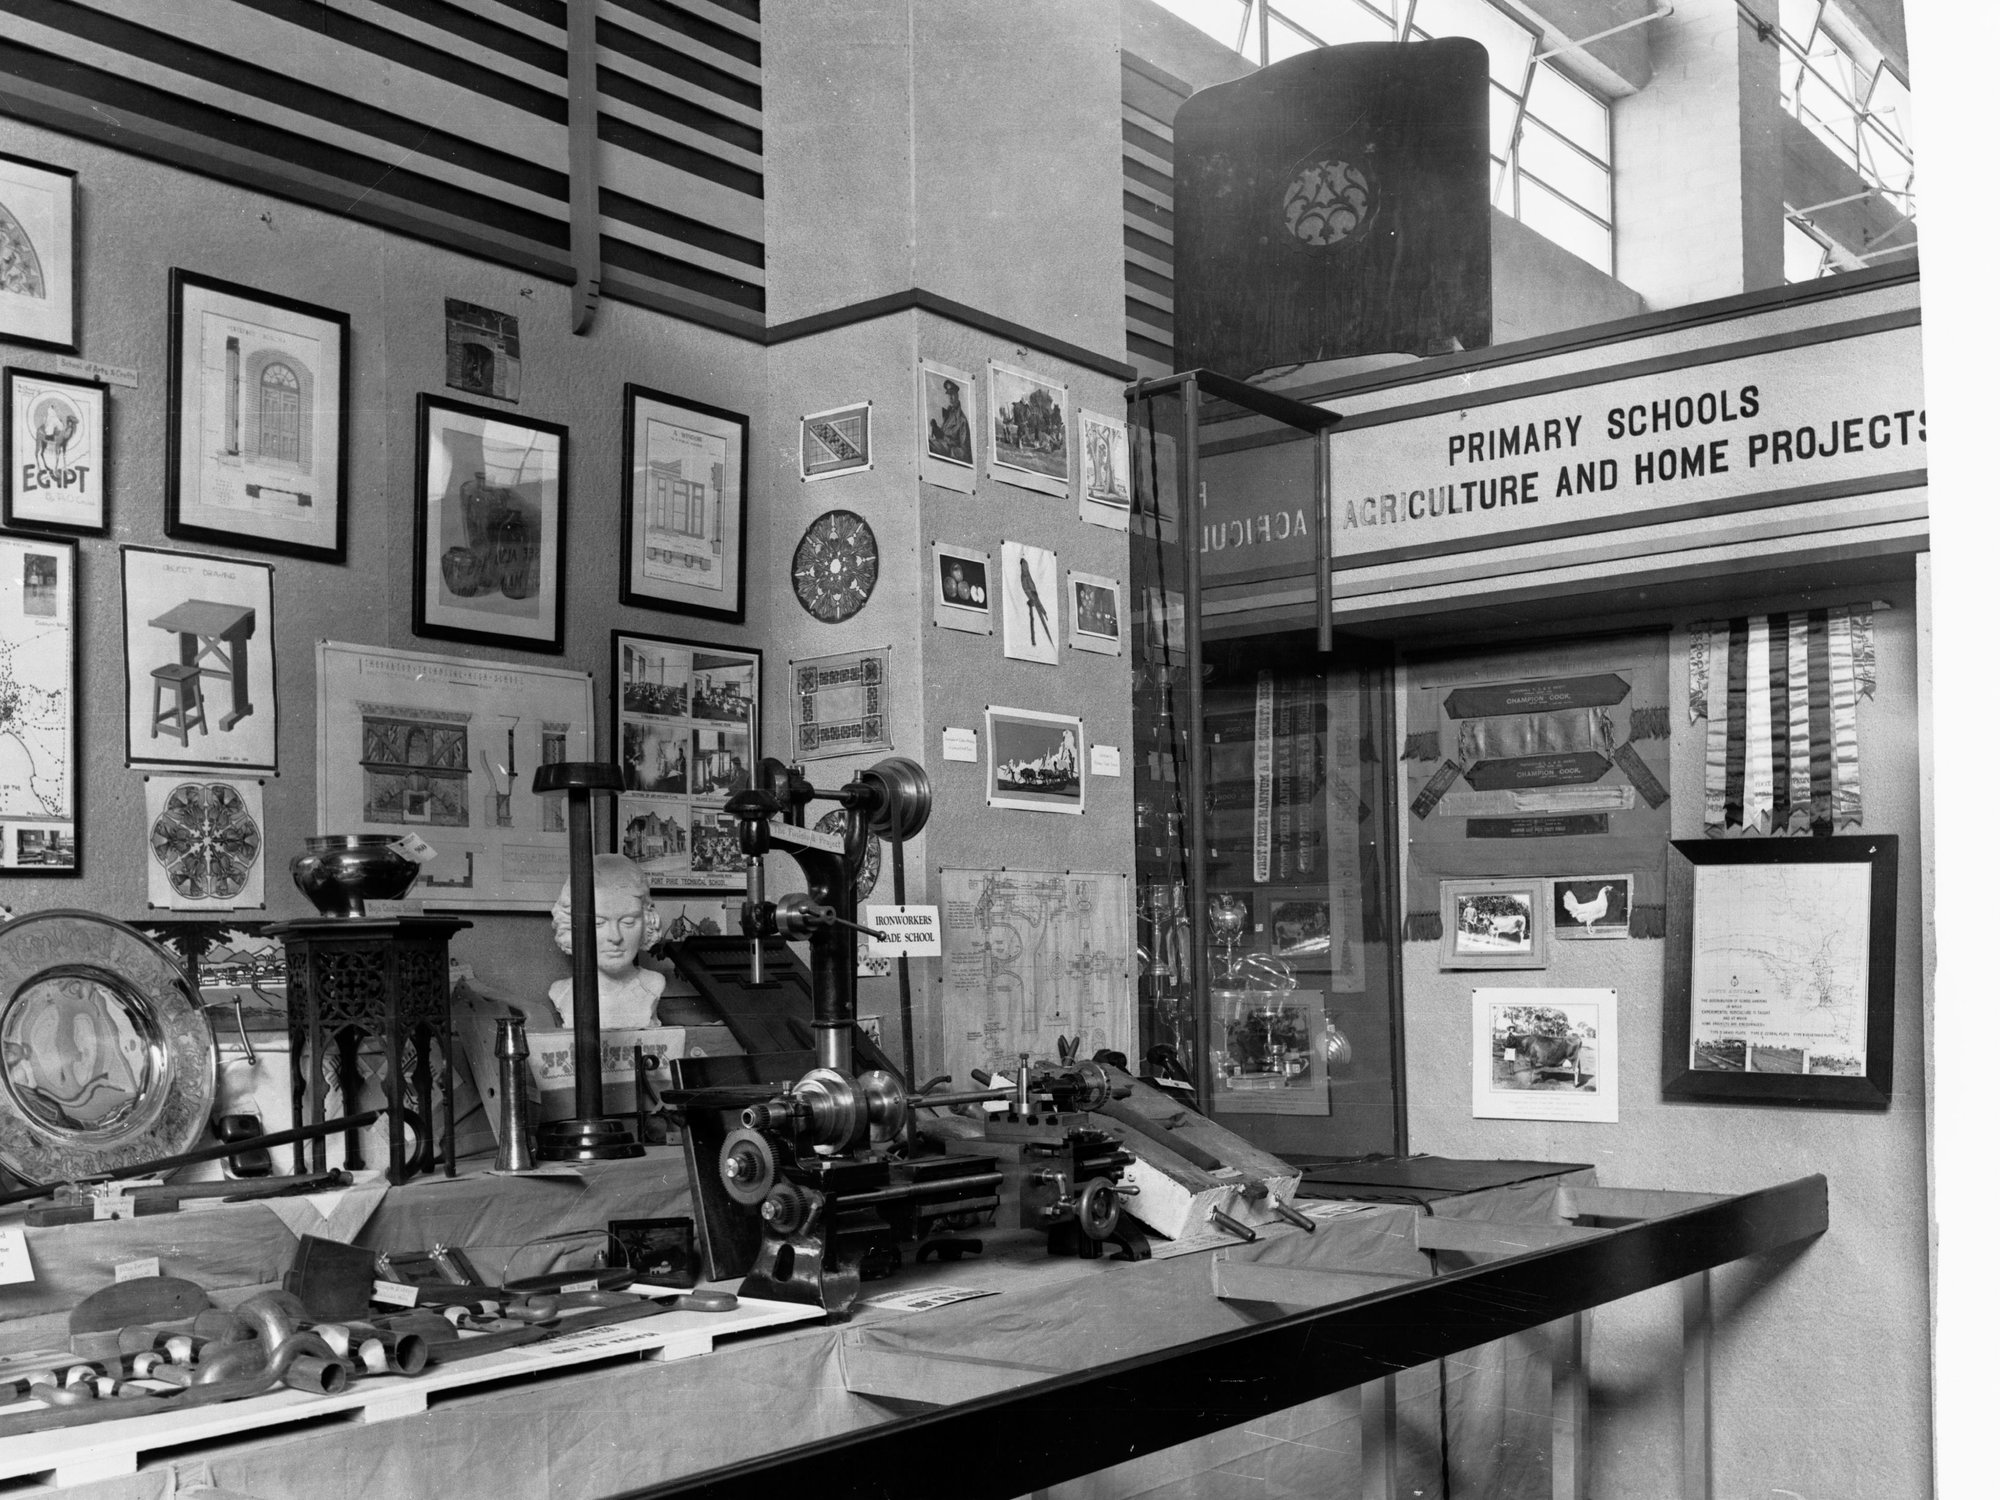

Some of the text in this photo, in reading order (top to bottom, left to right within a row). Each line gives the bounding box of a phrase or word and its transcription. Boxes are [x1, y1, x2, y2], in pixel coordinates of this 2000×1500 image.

[93, 365, 108, 376] Arts
[116, 369, 136, 380] Crafts
[1448, 385, 1760, 467] PRIMARY SCHOOLS
[23, 464, 90, 493] EGYPT
[1343, 472, 1538, 531] AGRICULTURE
[1556, 458, 1618, 498] AND
[1635, 439, 1730, 485] HOME
[1506, 695, 1544, 705] CHAMPION
[1516, 770, 1555, 778] CHAMPION
[1258, 774, 1269, 818] MANNUM
[1258, 820, 1268, 848] PRIZE
[1257, 850, 1268, 876] FIRST
[681, 878, 706, 886] TECHNICAL
[875, 916, 933, 926] IRONWORKERS
[877, 932, 935, 943] ADE SCHOOL
